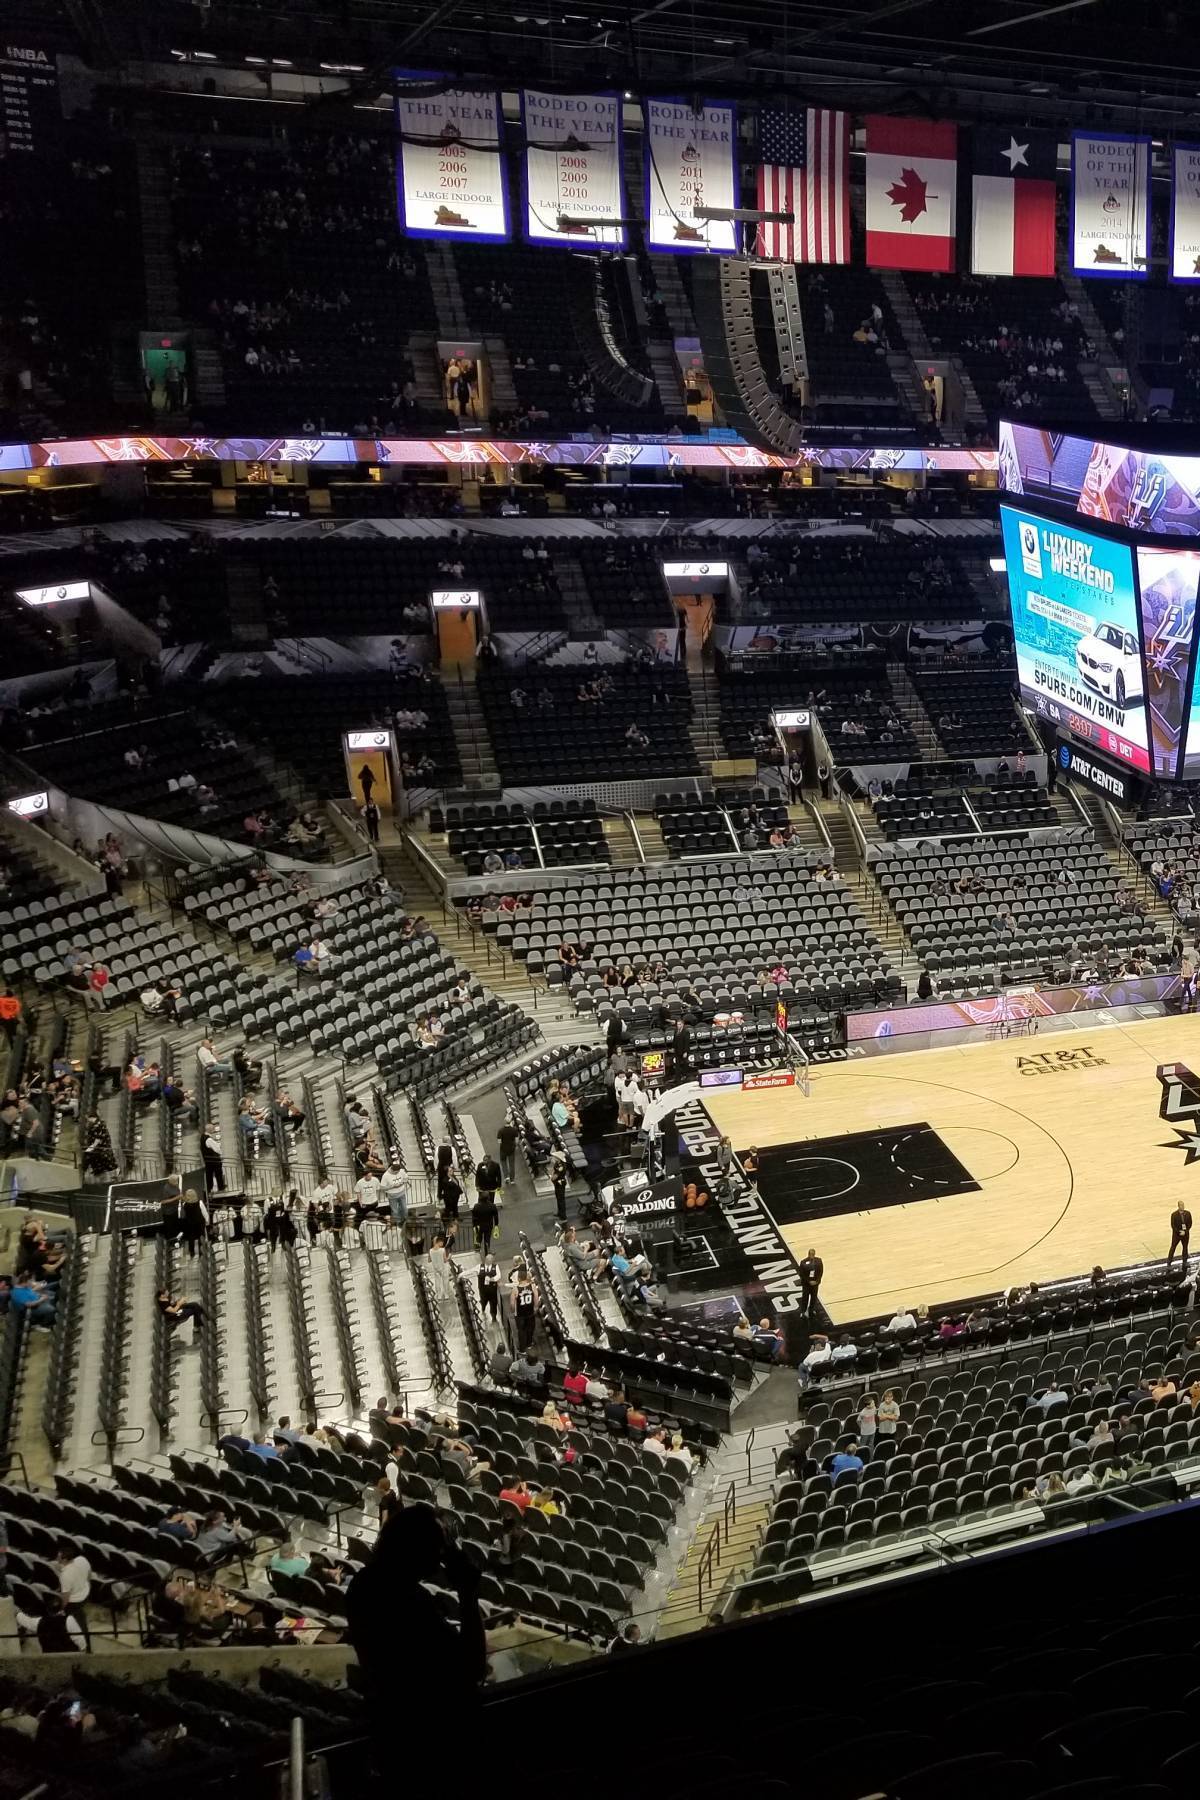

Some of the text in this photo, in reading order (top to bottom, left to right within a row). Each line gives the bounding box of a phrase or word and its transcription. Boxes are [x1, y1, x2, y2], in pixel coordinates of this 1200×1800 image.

[402, 101, 494, 120] THE YEAR
[527, 95, 617, 115] RODEO OF
[651, 105, 730, 124] RODEO OF
[529, 114, 615, 133] THE YEAR
[652, 124, 730, 142] THE YEAR
[438, 147, 466, 159] 2005
[1088, 143, 1136, 156] RODEO
[439, 161, 467, 174] 2006
[560, 157, 588, 169] 2008
[1086, 160, 1134, 174] OF THE
[561, 171, 588, 184] 2009
[680, 166, 703, 178] 2011
[440, 177, 468, 189] 2007
[680, 181, 704, 193] 2012
[1094, 177, 1129, 190] YEAR
[416, 190, 493, 203] LARGE INDOOR
[562, 186, 588, 199] 2010
[540, 200, 613, 213] LARGE INDOOR
[658, 209, 687, 218] LARGE
[1101, 217, 1123, 229] 2014
[1080, 230, 1142, 241] LARGE INDOOR
[1042, 530, 1094, 564] LUXURY
[1051, 553, 1115, 595] WEEKEND
[1034, 658, 1052, 675] ENTER
[1059, 670, 1072, 683] WIN
[1034, 669, 1126, 728] SPURS.COM/BMW
[1049, 703, 1061, 721] SA
[1119, 743, 1134, 759] DET
[1070, 755, 1125, 799] AT&T CENTER
[1015, 1046, 1096, 1069] AT&T
[1020, 1058, 1111, 1077] CENTER
[614, 1195, 677, 1217] PALDING
[698, 1161, 786, 1256] ANTOIO
[752, 1259, 803, 1313] SAN
[519, 1294, 533, 1306] 10
